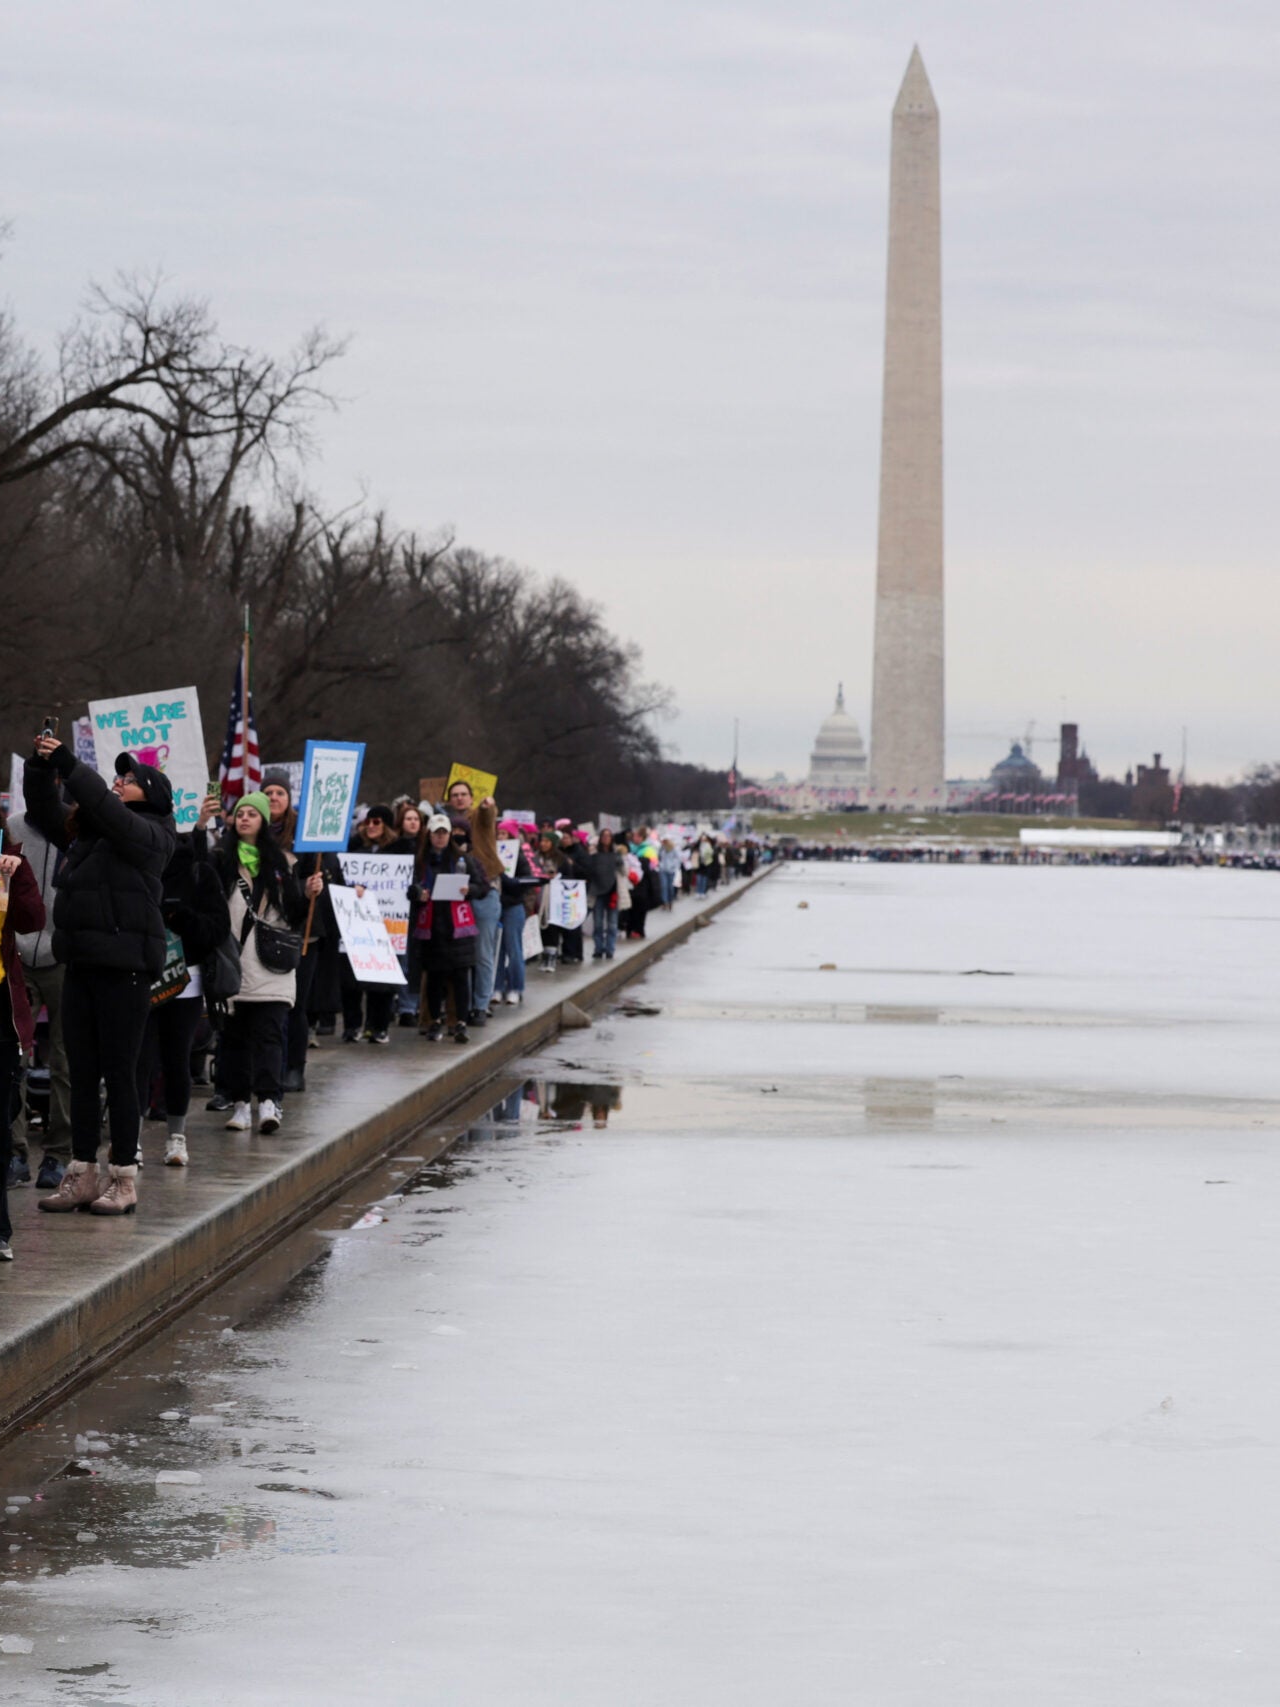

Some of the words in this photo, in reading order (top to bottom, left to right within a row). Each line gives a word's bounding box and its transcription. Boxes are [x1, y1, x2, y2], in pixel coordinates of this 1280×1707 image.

[95, 709, 130, 729] WE
[142, 701, 186, 723] ARE
[121, 723, 172, 747] NOT
[172, 788, 197, 806] Y-
[173, 805, 199, 824] NG
[362, 861, 389, 875] FOR
